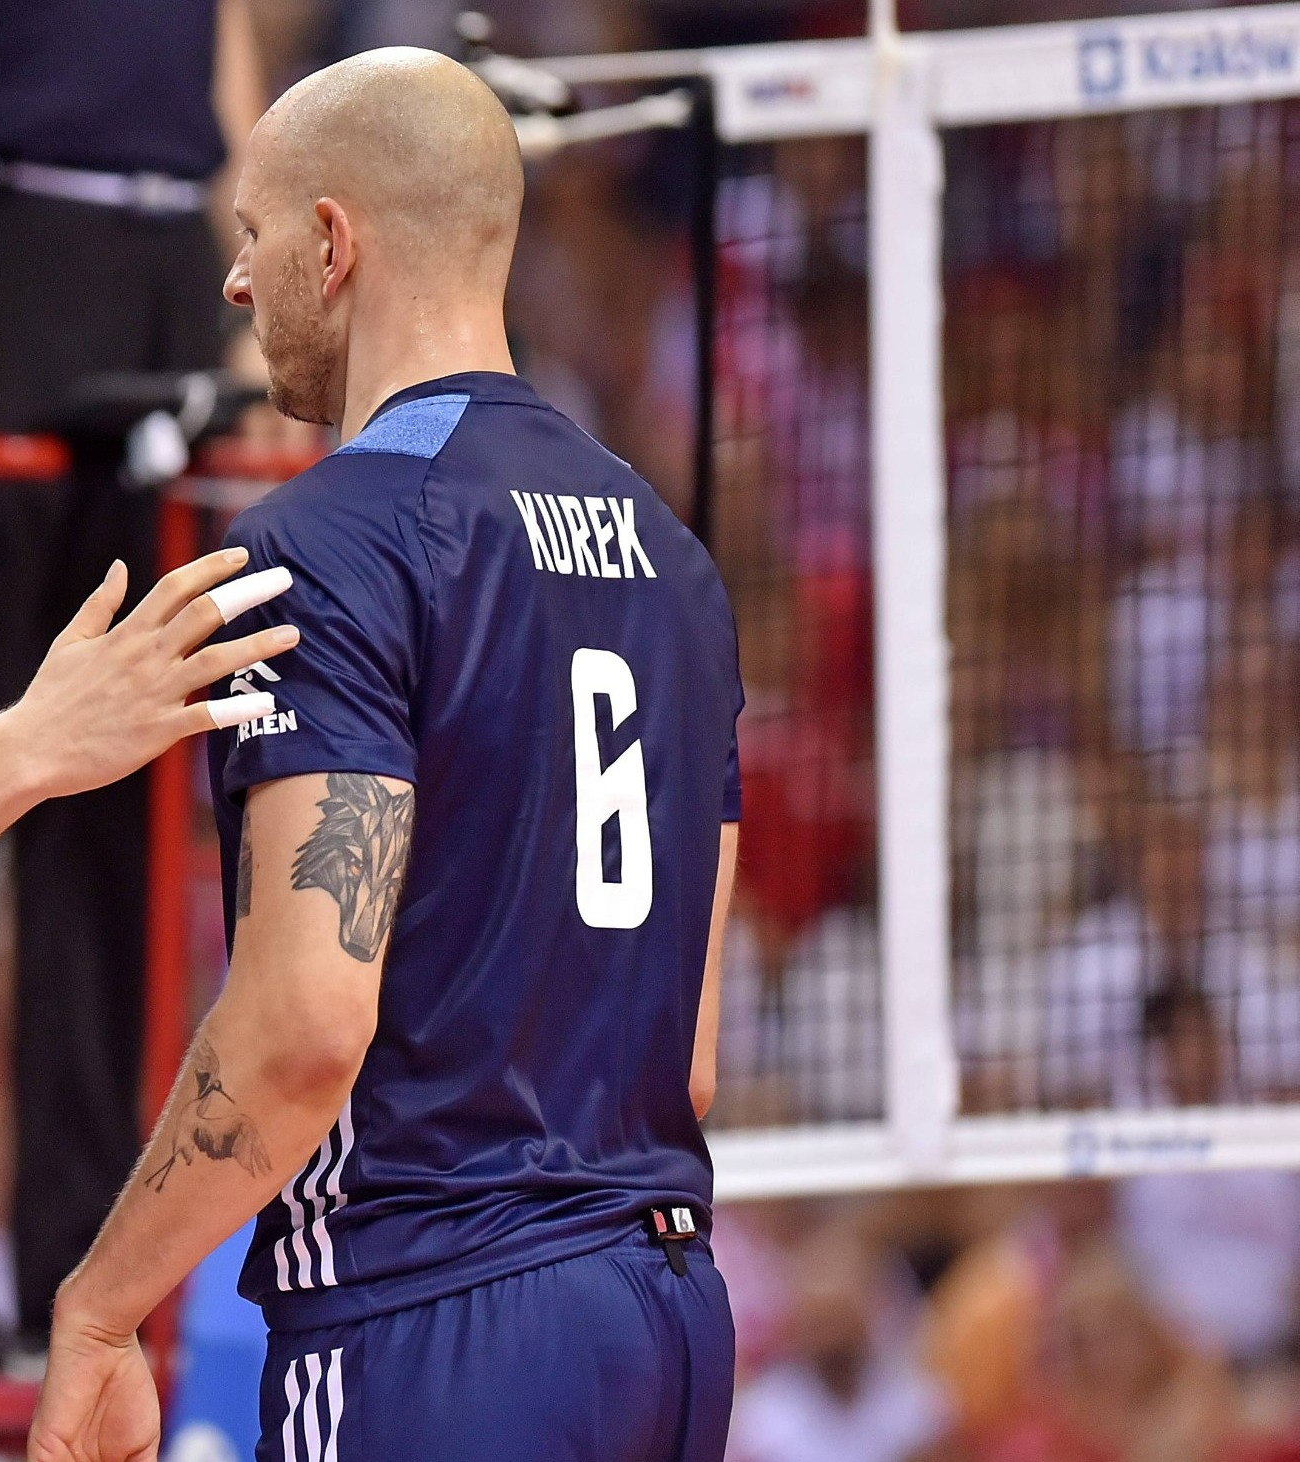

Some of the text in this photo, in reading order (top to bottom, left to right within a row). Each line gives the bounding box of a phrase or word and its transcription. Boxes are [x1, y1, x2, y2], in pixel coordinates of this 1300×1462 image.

[509, 489, 658, 579] KUREK
[236, 709, 298, 749] RLEN
[570, 647, 653, 929] 6
[678, 1209, 689, 1232] 6
